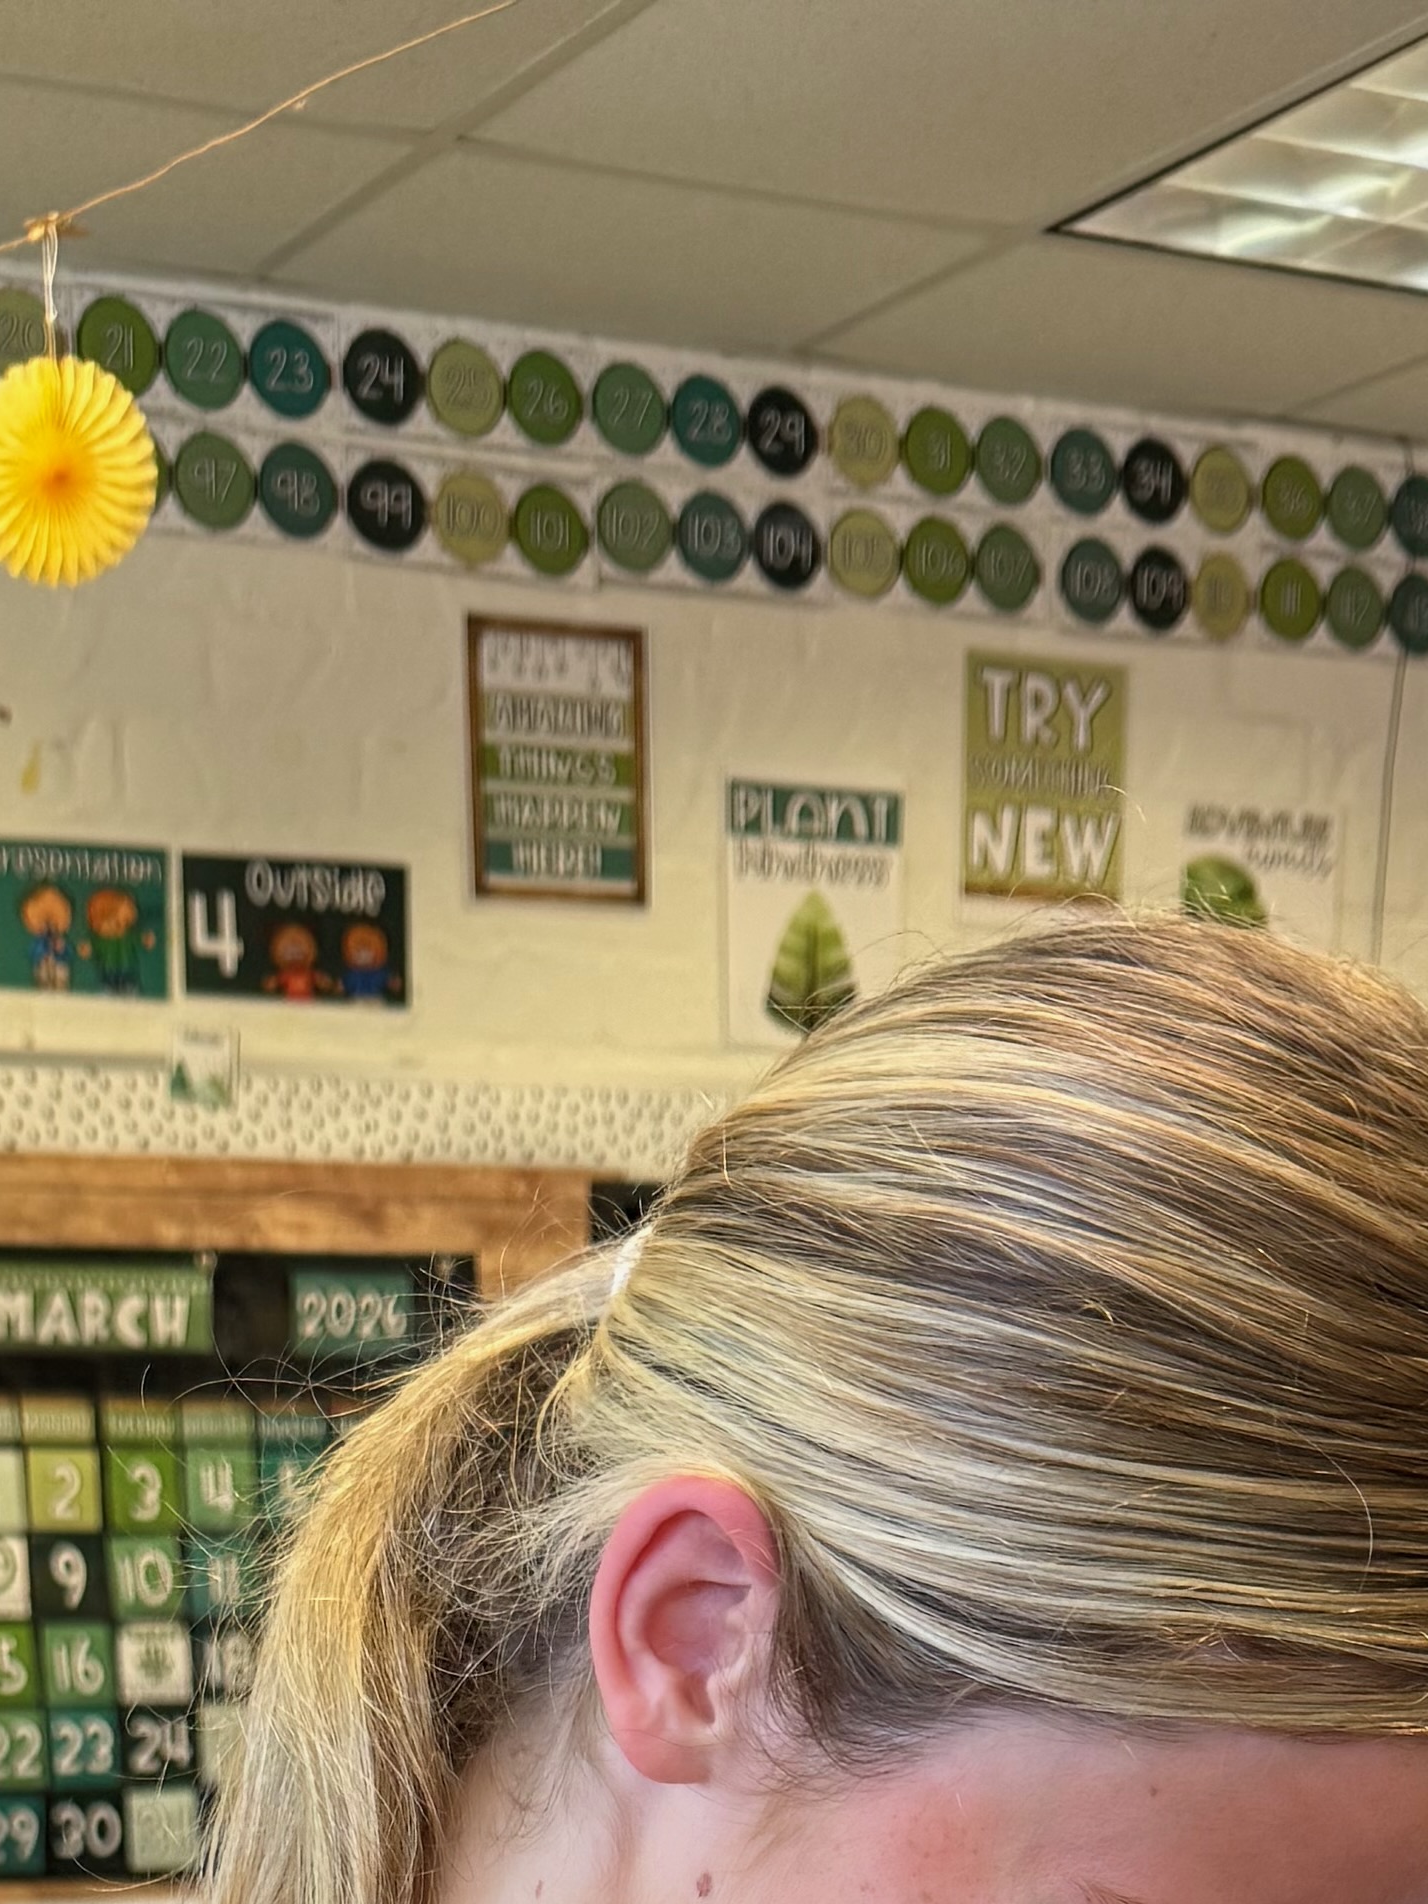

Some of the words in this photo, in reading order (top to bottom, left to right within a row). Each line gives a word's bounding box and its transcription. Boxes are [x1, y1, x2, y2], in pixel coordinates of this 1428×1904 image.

[105, 323, 134, 373] 21
[186, 337, 228, 383] 22
[265, 347, 314, 395] 23
[356, 357, 405, 402] 24
[526, 375, 568, 420] 26
[612, 385, 654, 428] 27
[762, 408, 807, 458] 29
[192, 457, 237, 503] 97
[276, 468, 320, 518] 98
[362, 482, 413, 530] 99
[444, 493, 505, 534] 100
[529, 508, 570, 548] 101
[606, 503, 660, 546] 102
[687, 510, 743, 559] 103
[762, 527, 813, 577] 104
[981, 667, 1109, 751] TRY
[972, 805, 1121, 884] NEW
[187, 889, 244, 979] 4
[296, 1292, 407, 1341] 2026
[52, 1463, 83, 1521] 2
[129, 1461, 162, 1522] 3
[199, 1456, 236, 1512] 4
[48, 1542, 87, 1608] 9
[118, 1547, 173, 1606] 10
[54, 1635, 106, 1697] 16
[52, 1718, 114, 1775] 23
[126, 1716, 192, 1775] 24
[49, 1803, 122, 1860] 30
